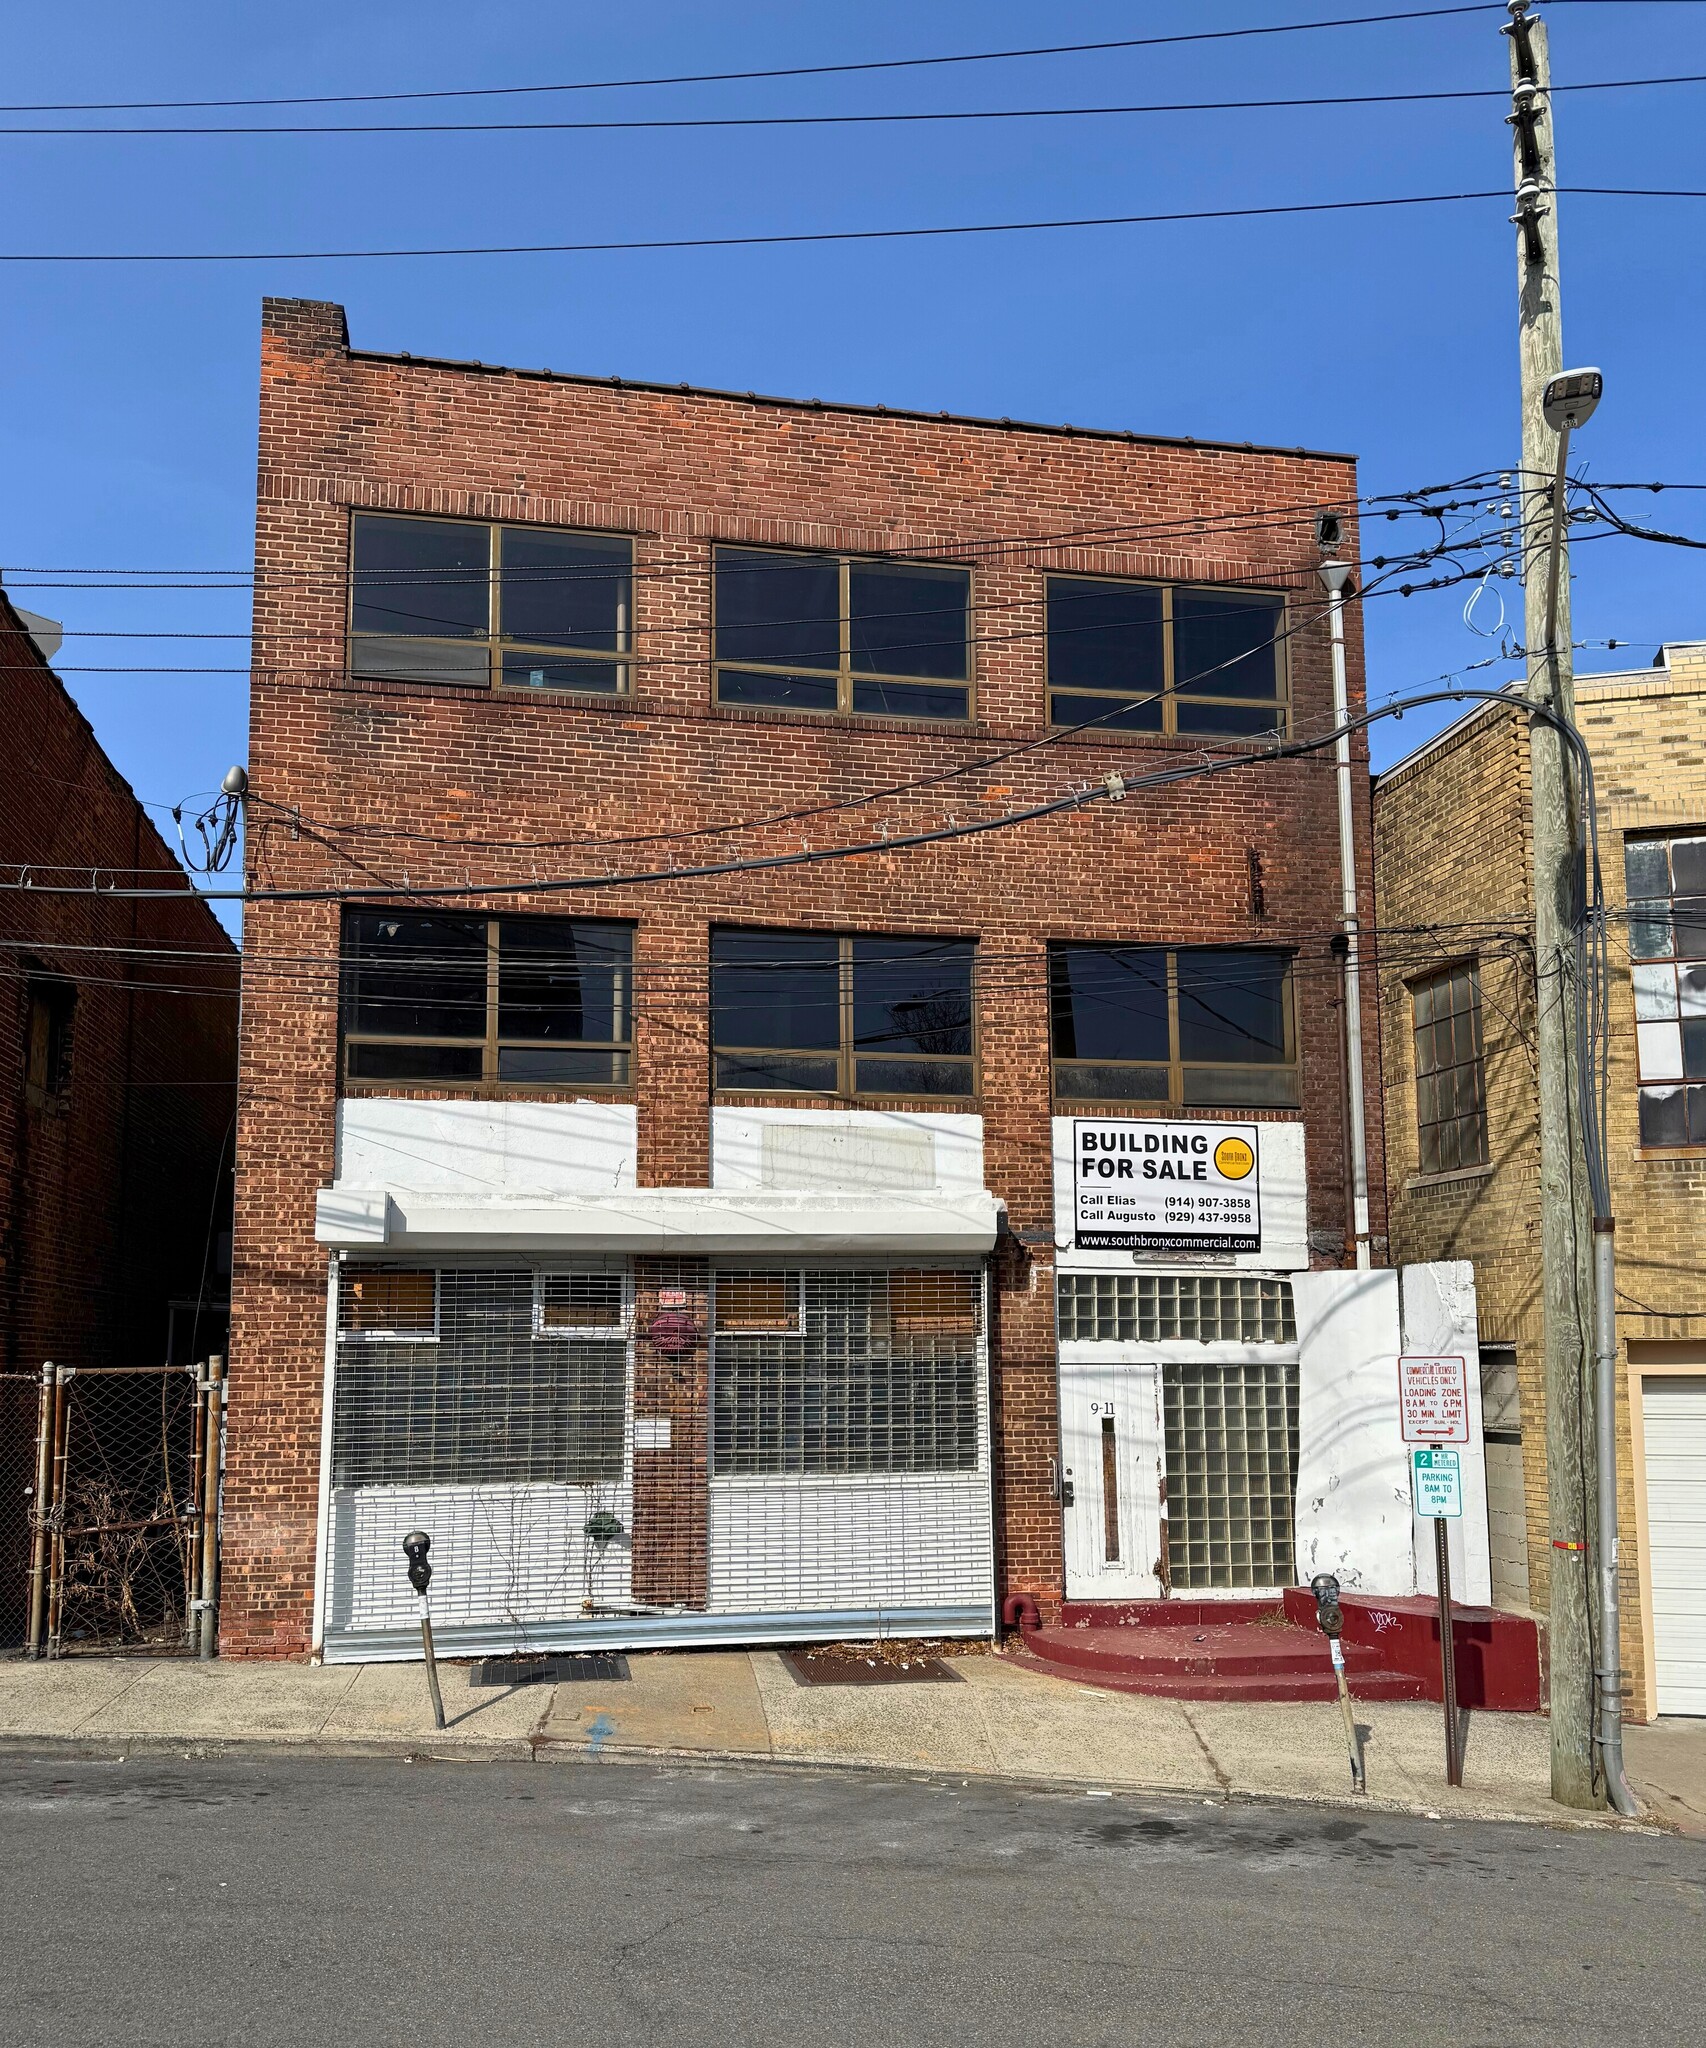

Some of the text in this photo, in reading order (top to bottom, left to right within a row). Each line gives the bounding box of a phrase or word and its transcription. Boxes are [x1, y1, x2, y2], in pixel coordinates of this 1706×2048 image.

[1082, 1132, 1208, 1154] BUILDING
[1082, 1158, 1208, 1181] FOR SALE
[1080, 1195, 1136, 1206] Call Elias
[1164, 1196, 1251, 1209] (914) 907-3858
[1080, 1210, 1156, 1223] Call Augusto
[1164, 1211, 1251, 1224] (929) 437-9958
[1081, 1235, 1256, 1249] www.southbronxcommercial.com
[1407, 1376, 1457, 1385] VEHICLES ONLY
[1404, 1388, 1462, 1397] LOADING ZONE
[1090, 1402, 1116, 1415] 9-11
[1405, 1399, 1411, 1408] 8
[1443, 1399, 1449, 1408] 6
[1407, 1410, 1418, 1418] 30
[1441, 1410, 1462, 1418] LIMIT
[1420, 1453, 1428, 1466] 2
[1422, 1473, 1453, 1482] PARKING
[1424, 1484, 1452, 1493] 8AM TO
[1431, 1495, 1447, 1504] 8PM
